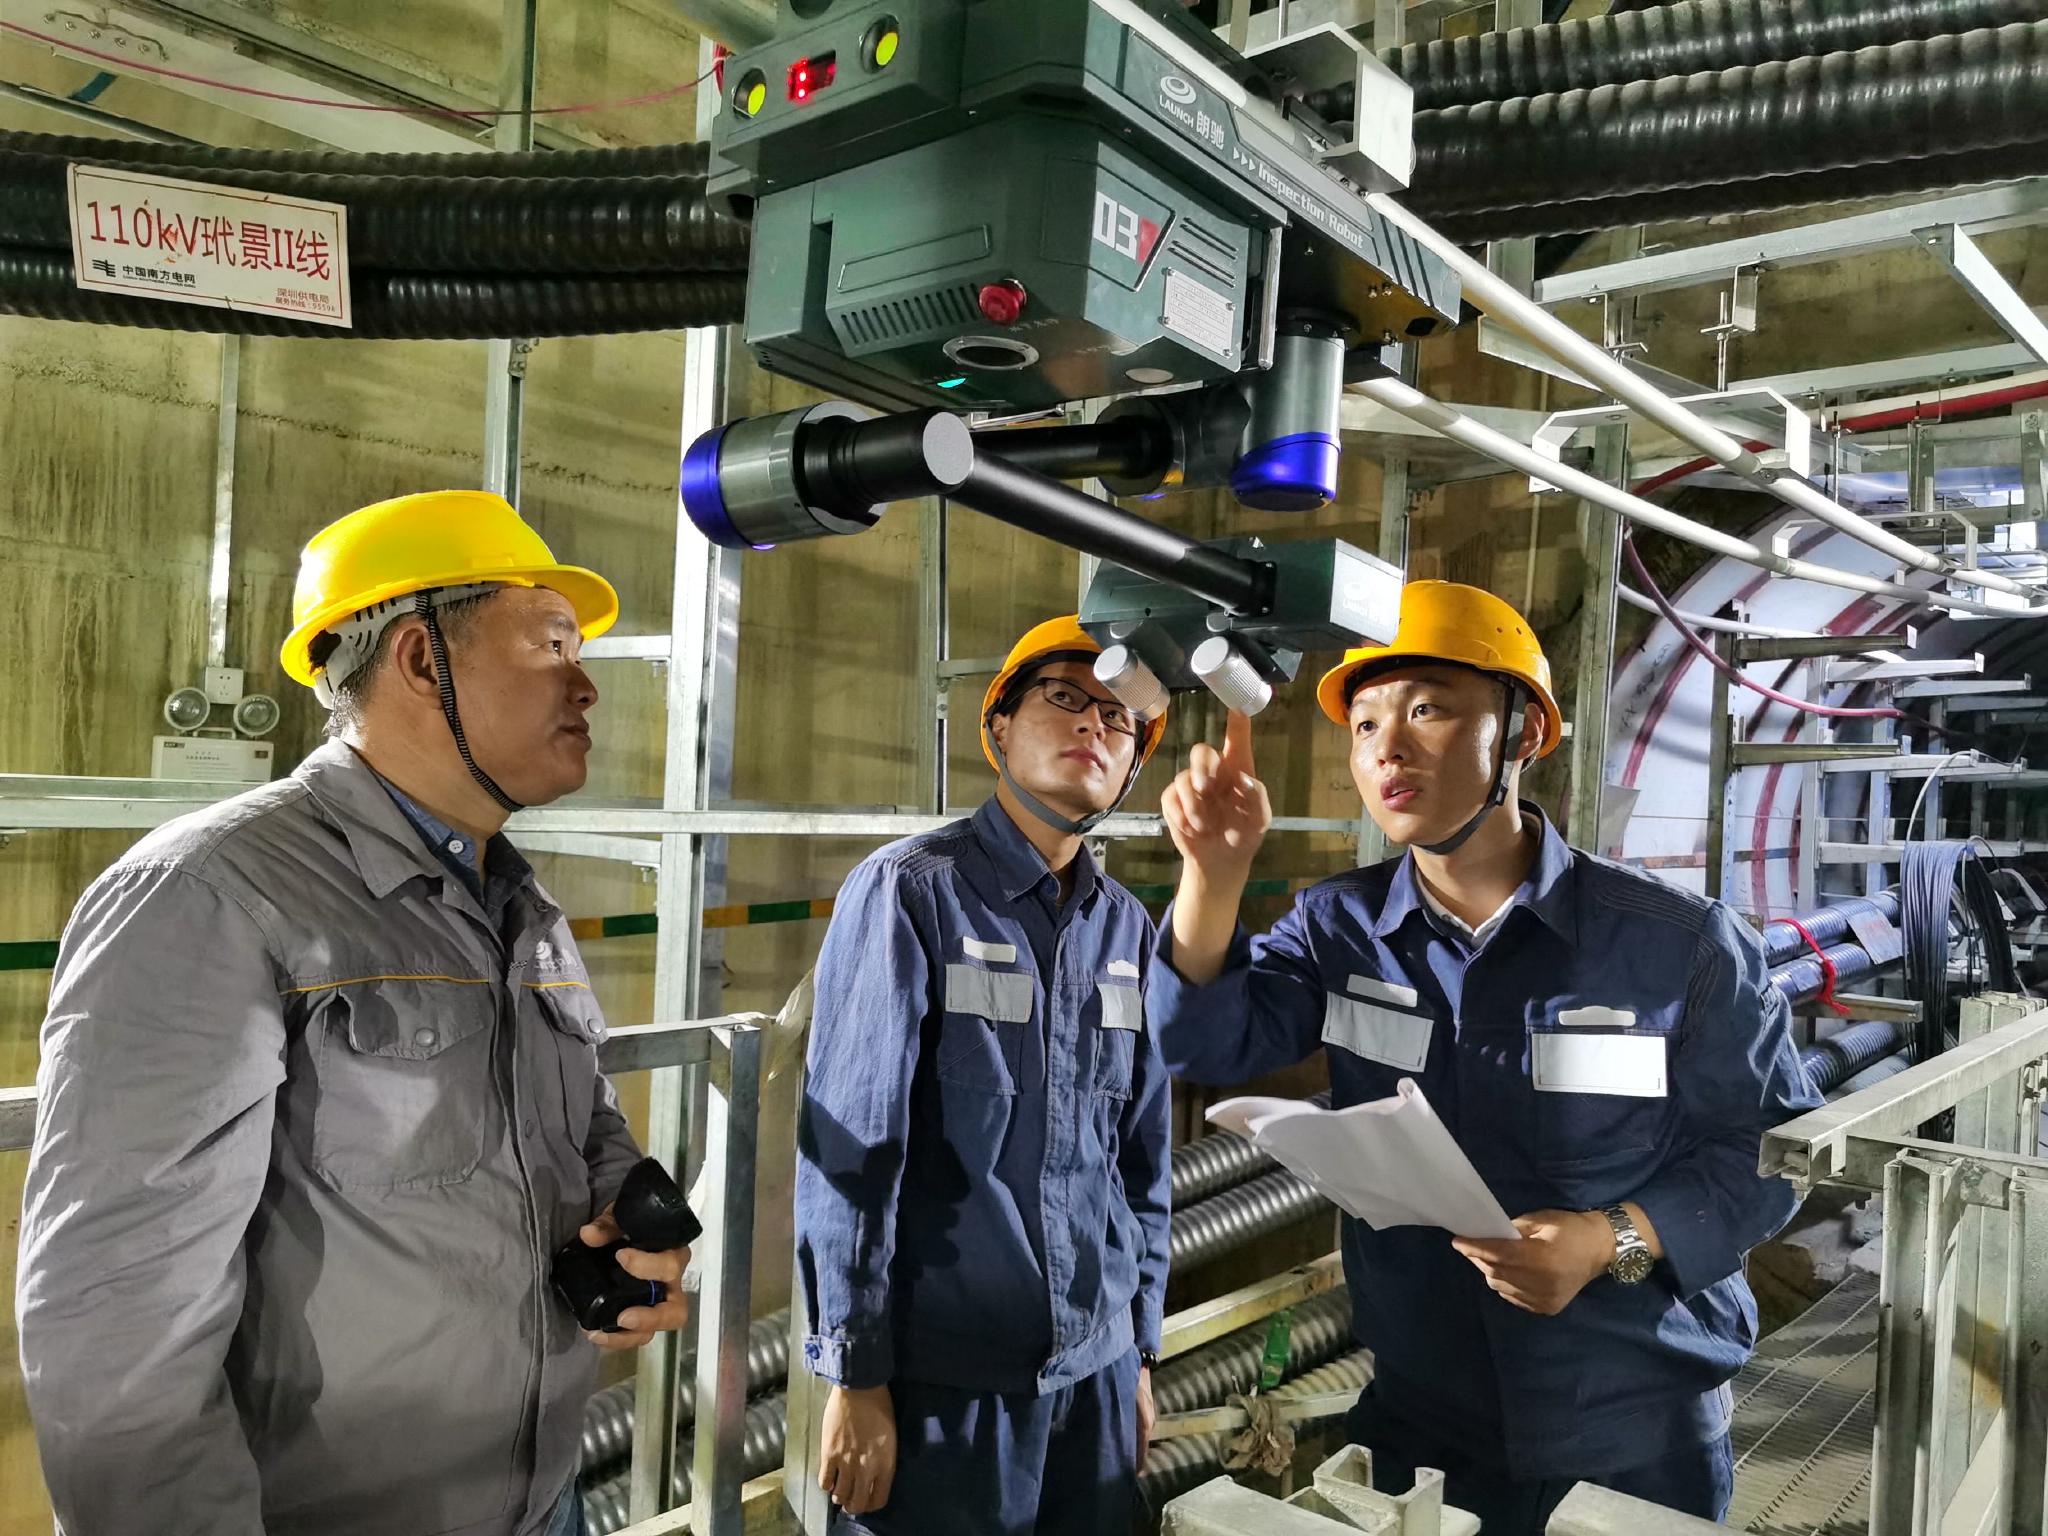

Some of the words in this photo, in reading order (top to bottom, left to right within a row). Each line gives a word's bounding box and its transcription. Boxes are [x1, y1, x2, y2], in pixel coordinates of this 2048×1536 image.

[1159, 94, 1194, 129] LAUNCH
[1196, 110, 1225, 150] 朗驰
[1093, 190, 1139, 261] 03
[1258, 162, 1326, 222] Inspection
[1328, 212, 1364, 249] Robot
[87, 201, 329, 281] 110kV玳景II线
[122, 265, 195, 284] 中国南方电网
[277, 287, 330, 304] 深圳供电局
